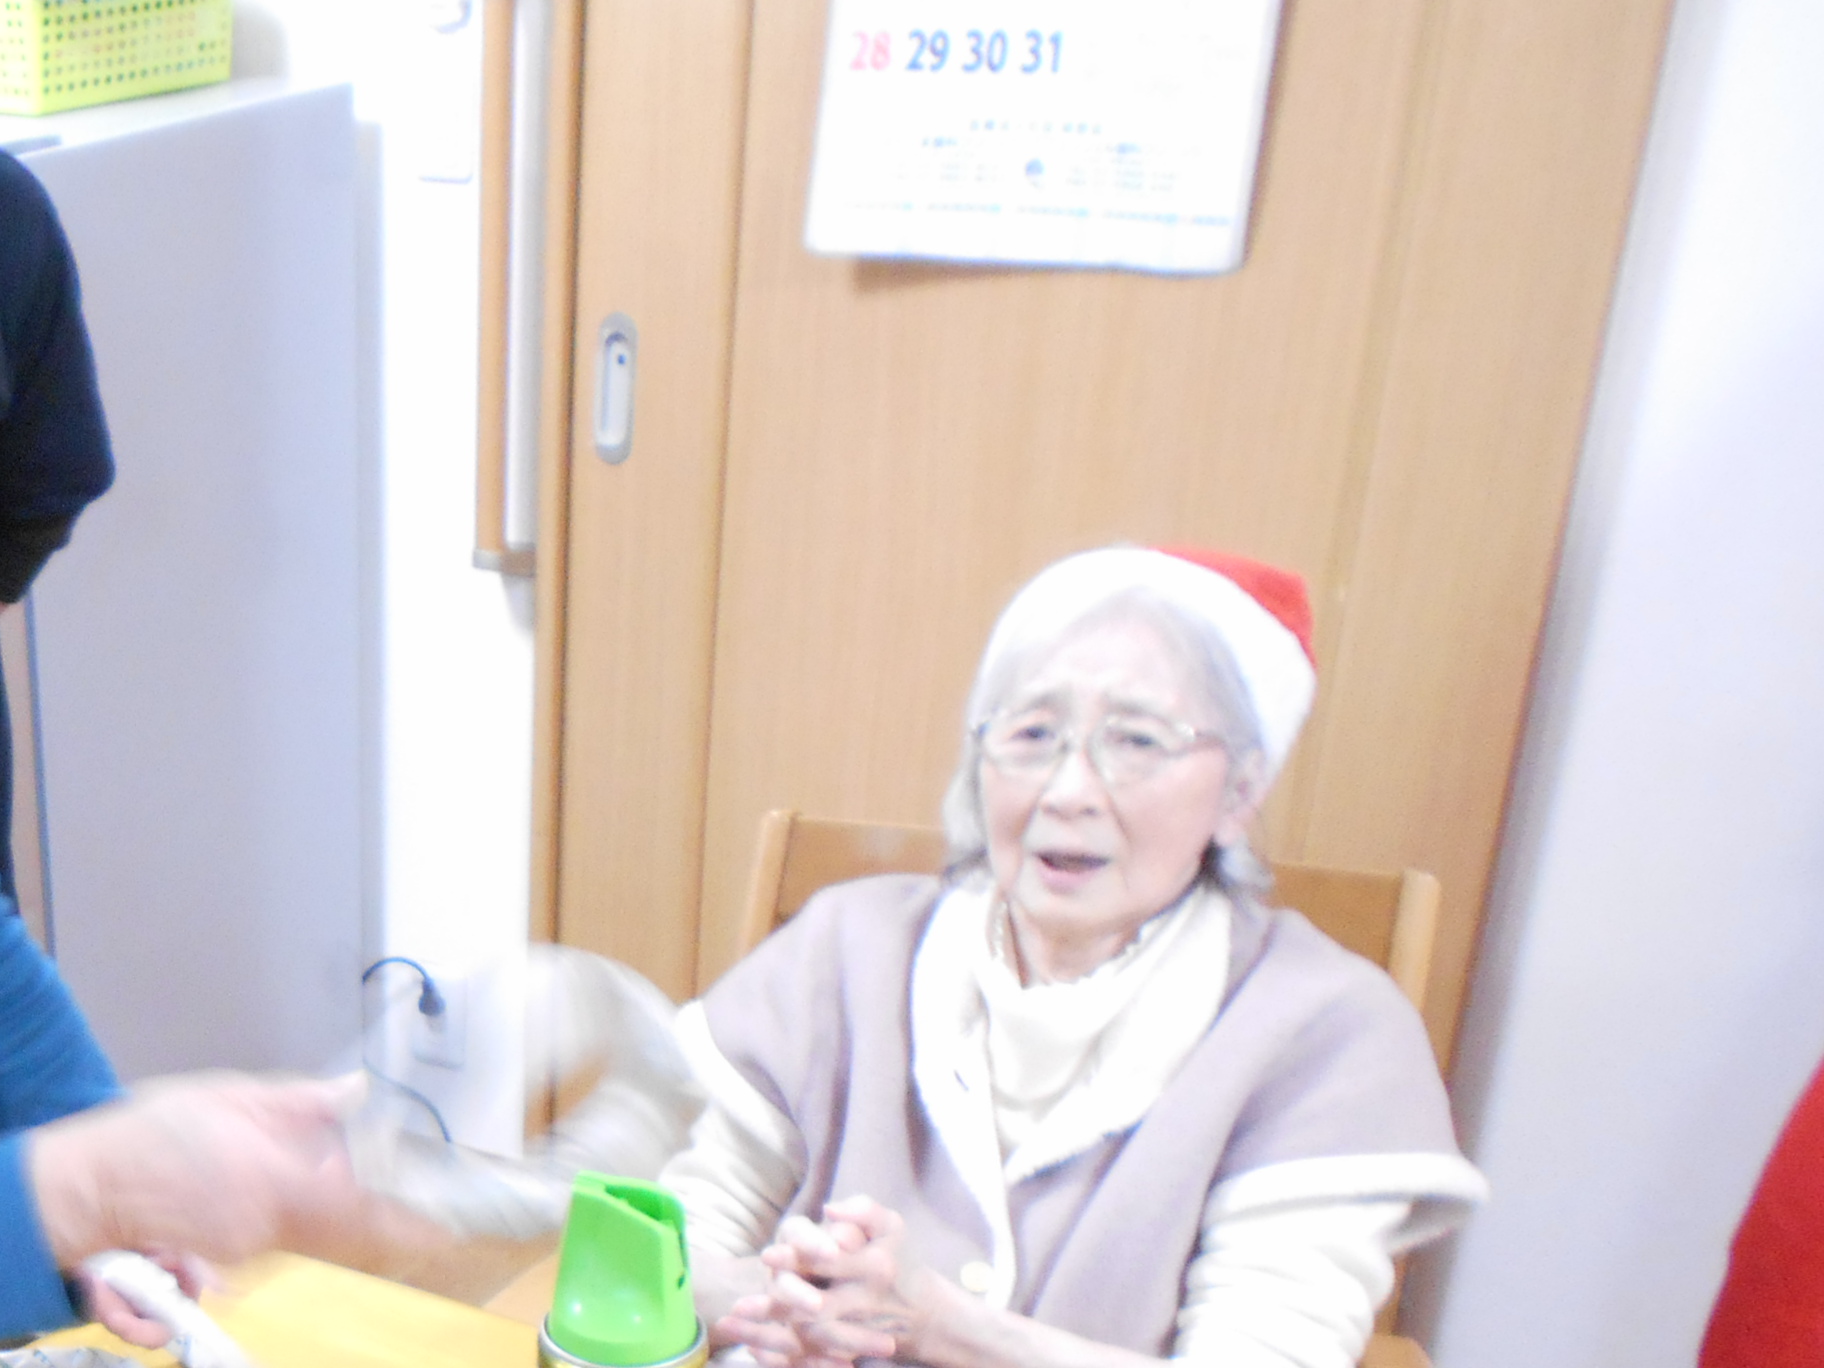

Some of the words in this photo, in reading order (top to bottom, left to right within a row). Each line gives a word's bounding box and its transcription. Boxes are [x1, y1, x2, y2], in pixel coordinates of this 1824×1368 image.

[851, 31, 891, 70] 28
[906, 30, 950, 72] 29
[962, 30, 1008, 73] 30
[1021, 30, 1062, 73] 31
